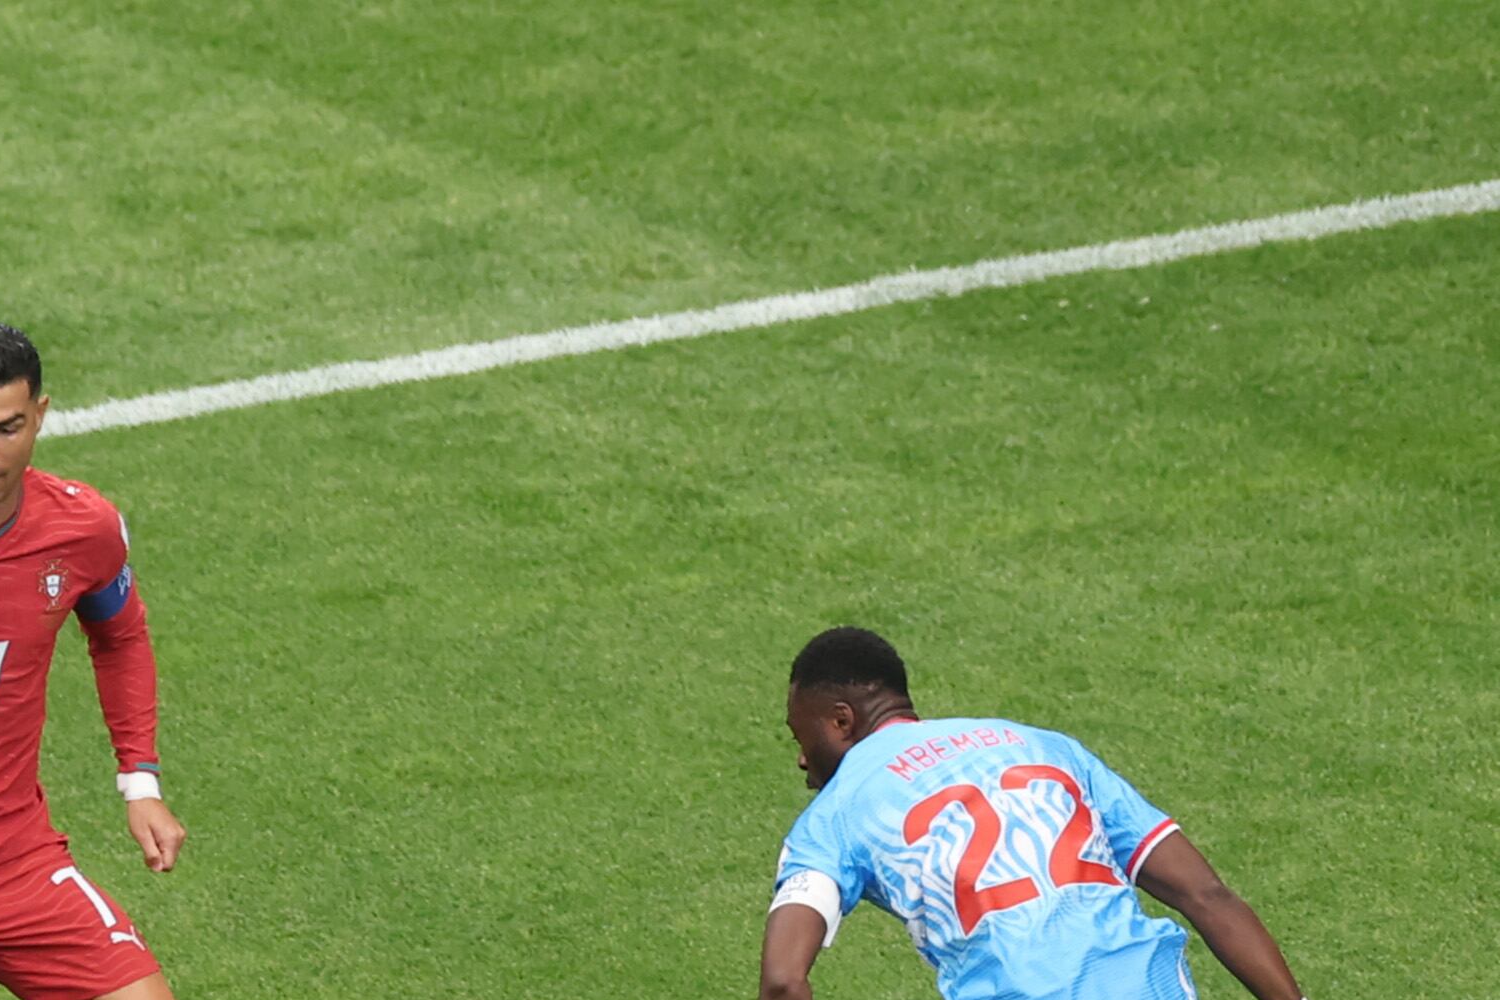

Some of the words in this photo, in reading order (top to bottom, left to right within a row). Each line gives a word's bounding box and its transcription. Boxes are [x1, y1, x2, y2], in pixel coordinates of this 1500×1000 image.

[886, 728, 1027, 782] MBEMBA
[902, 764, 1127, 937] 22
[50, 865, 117, 929] 7
